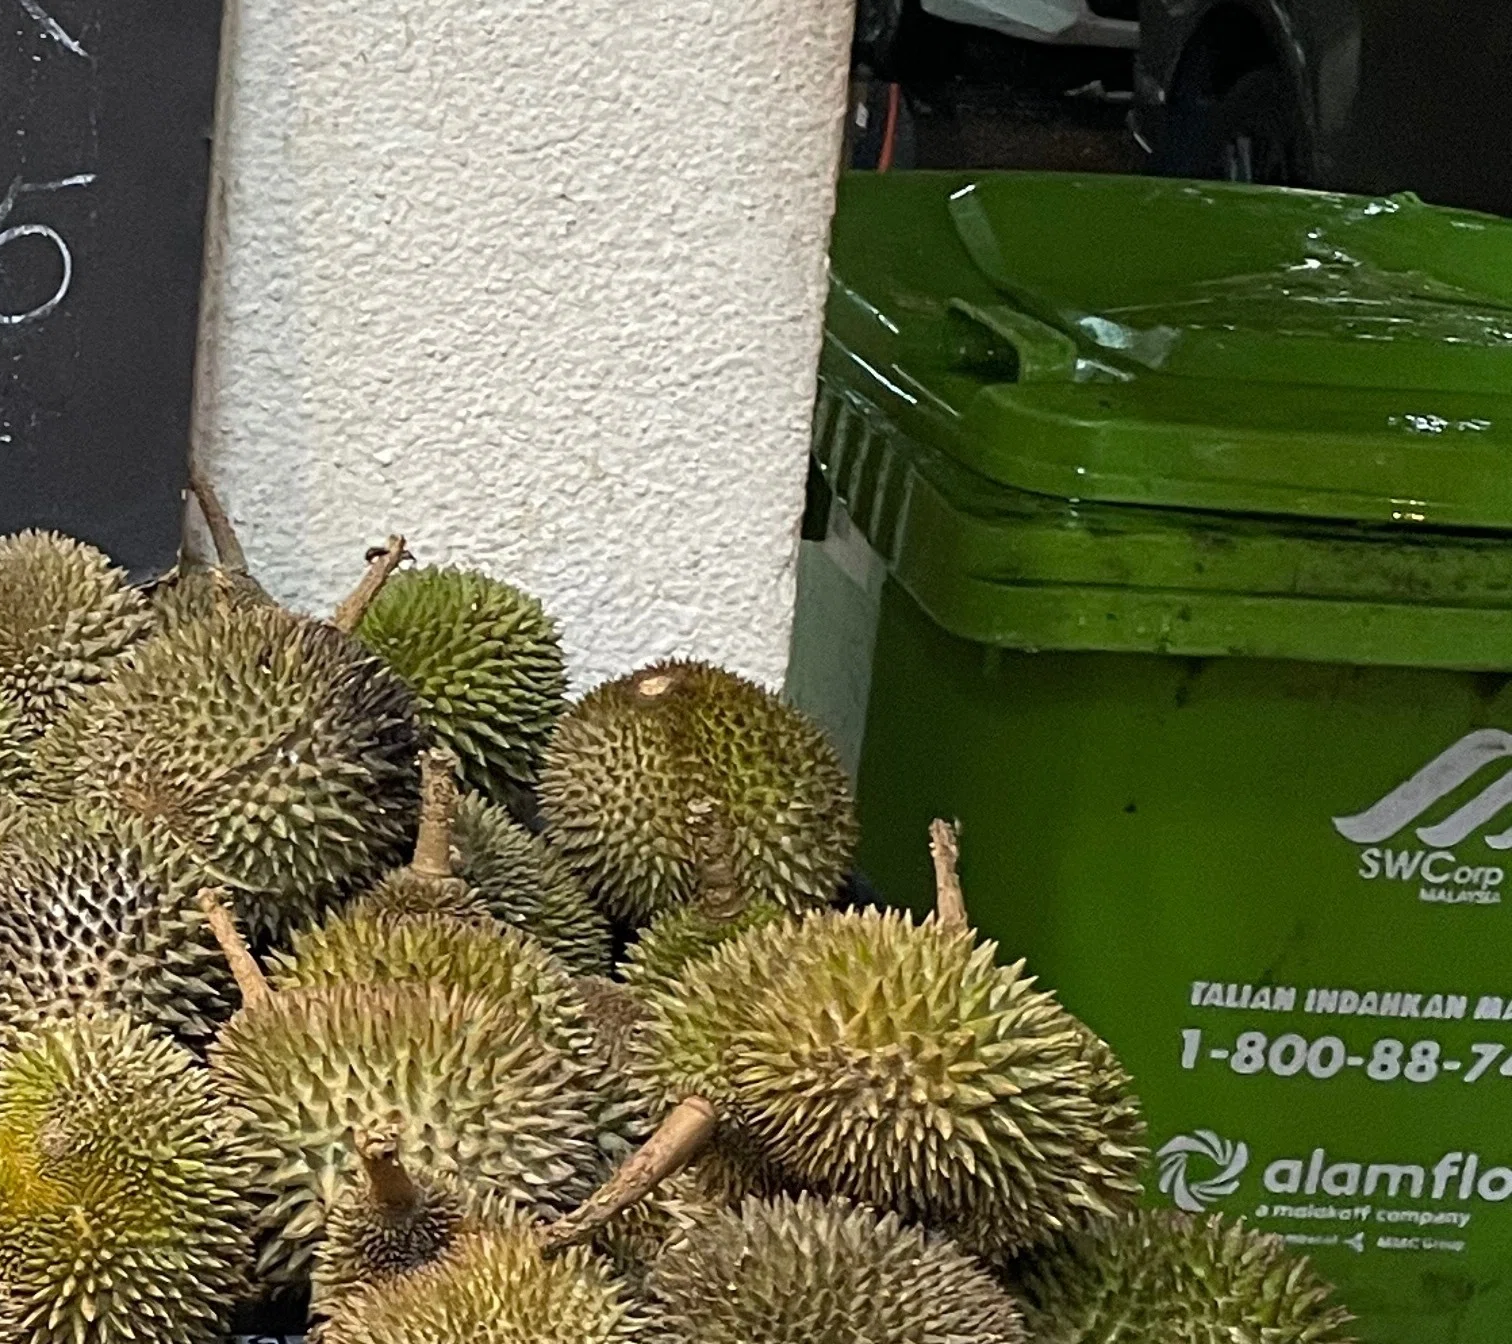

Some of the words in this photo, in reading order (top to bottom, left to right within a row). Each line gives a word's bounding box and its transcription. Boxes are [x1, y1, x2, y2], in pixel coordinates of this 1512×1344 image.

[1358, 847, 1505, 890] SWCorp
[1191, 981, 1296, 1012] TALIAN
[1304, 988, 1468, 1019] INDAHKAN
[1263, 1148, 1512, 1201] alamflo
[1375, 1209, 1472, 1229] company
